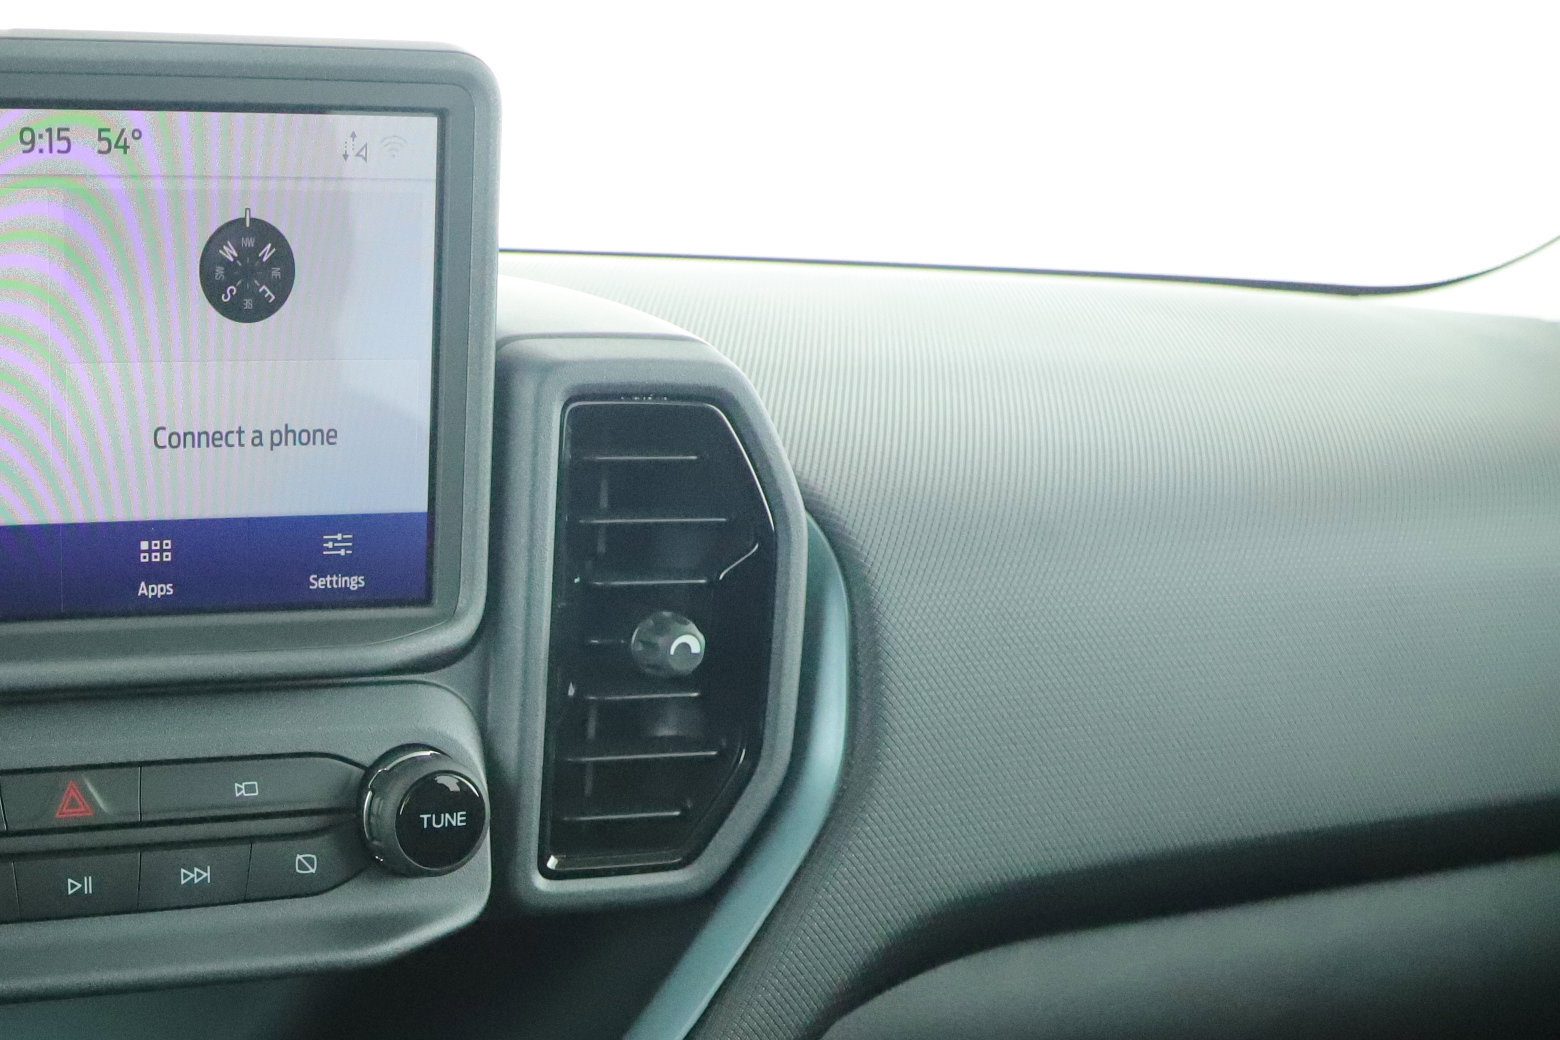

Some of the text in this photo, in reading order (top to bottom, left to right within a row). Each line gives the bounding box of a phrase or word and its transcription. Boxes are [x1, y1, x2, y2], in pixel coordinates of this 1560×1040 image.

[19, 126, 143, 155] 9:15 54°
[218, 240, 238, 262] W
[241, 236, 256, 248] NW
[258, 242, 276, 262] N
[221, 285, 237, 303] S
[258, 284, 276, 304] E
[153, 423, 338, 451] Connect a phone
[138, 581, 174, 599] Apps
[309, 574, 365, 591] Settings
[419, 811, 467, 829] TUNE
